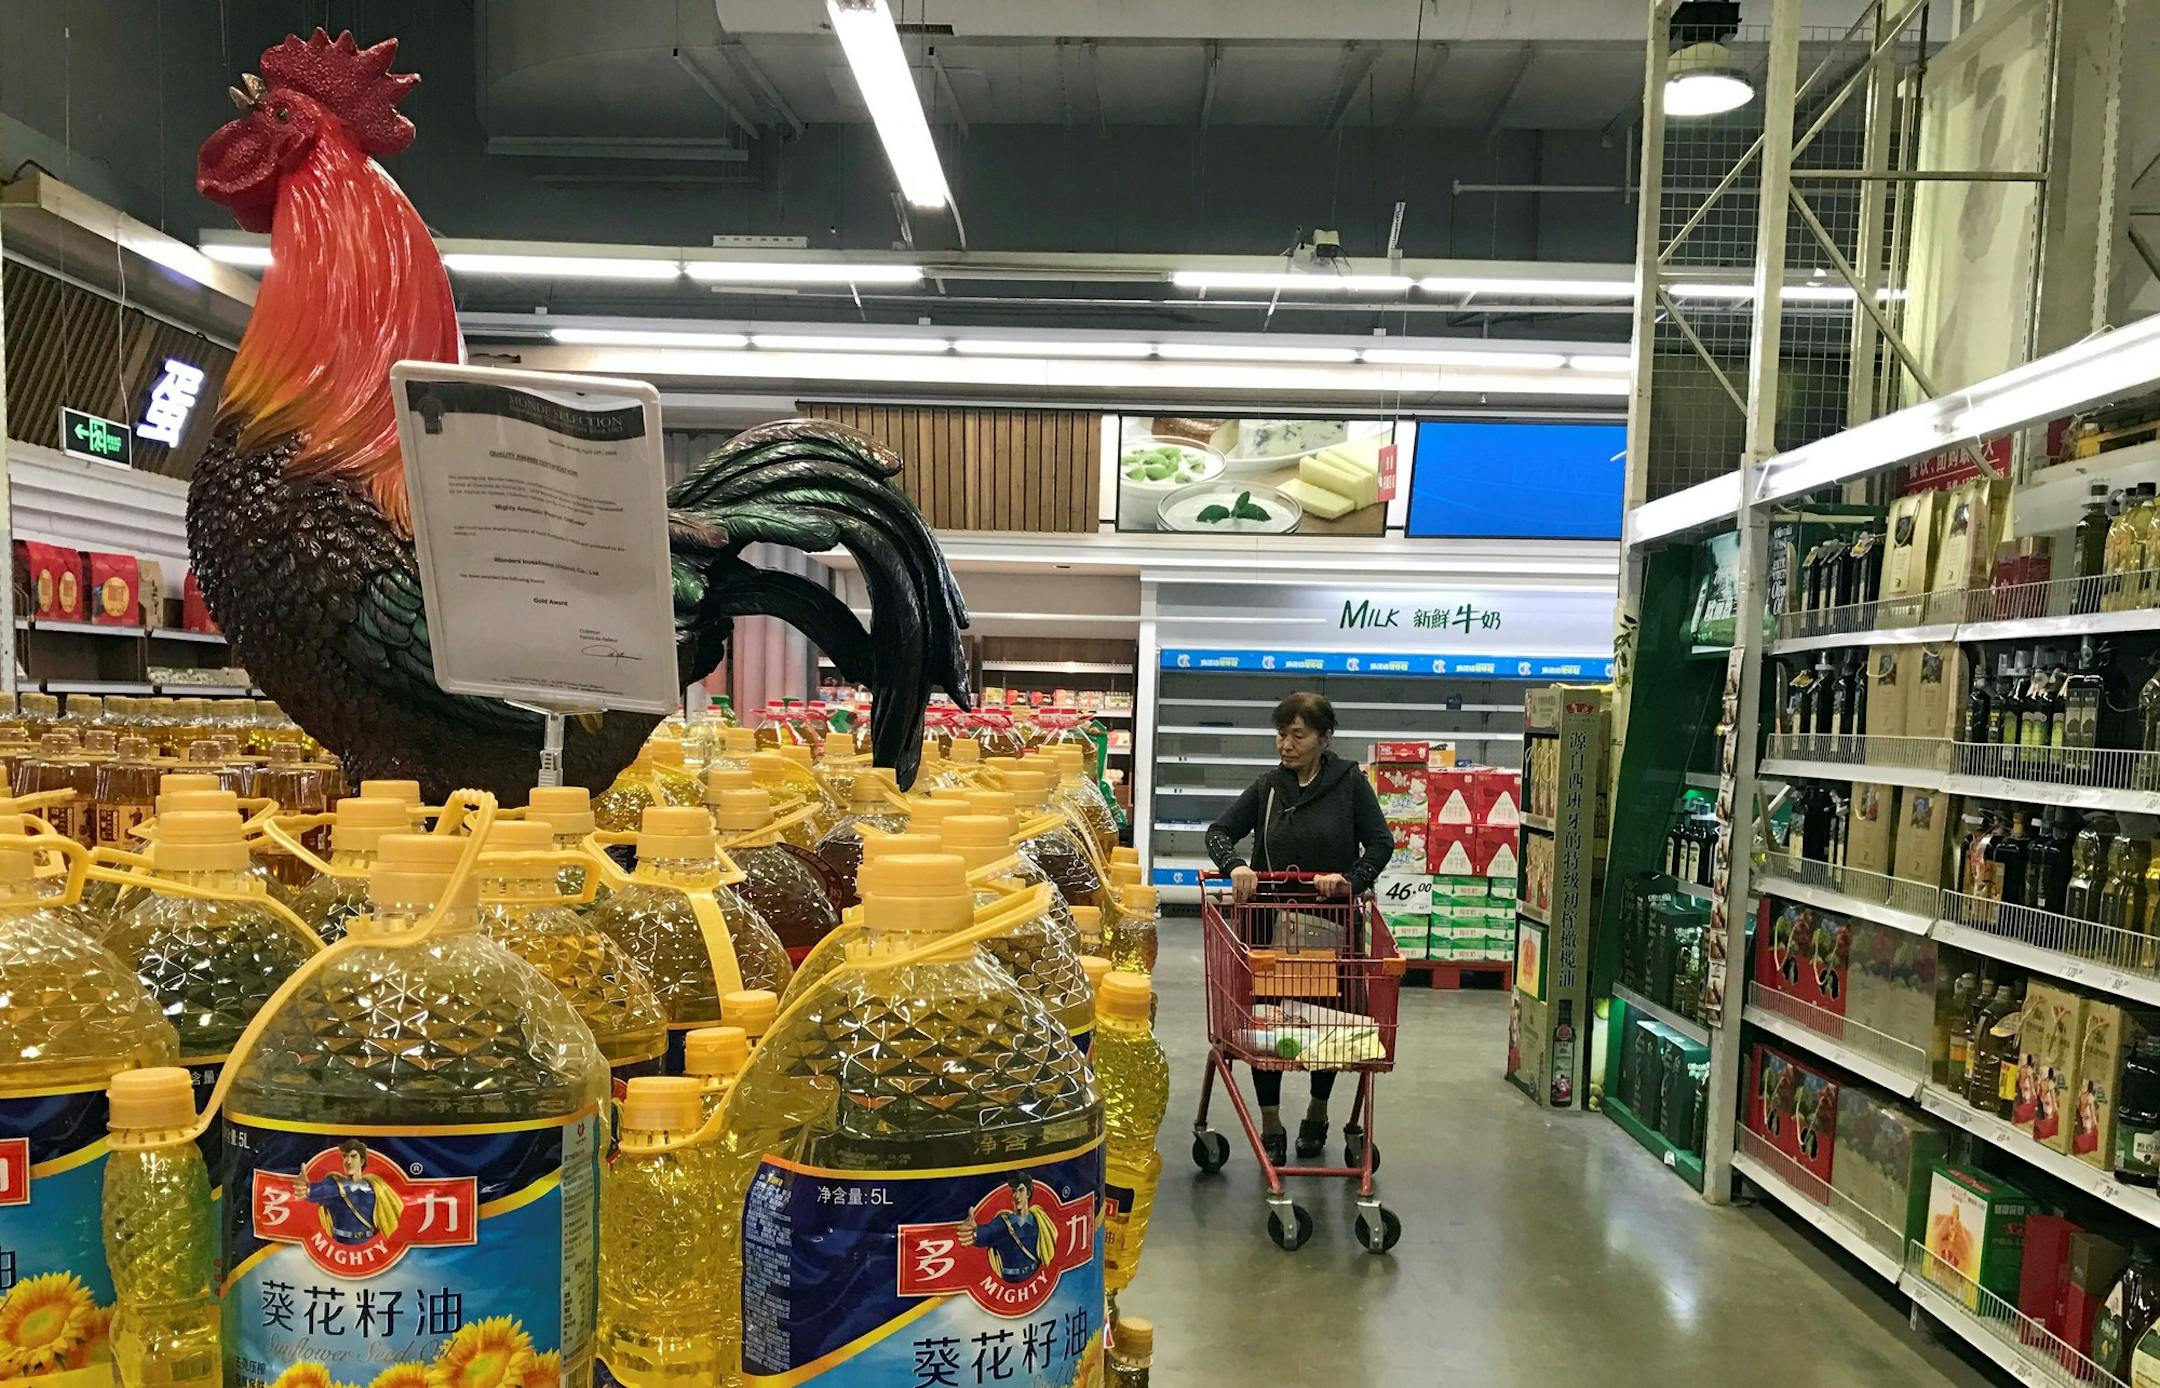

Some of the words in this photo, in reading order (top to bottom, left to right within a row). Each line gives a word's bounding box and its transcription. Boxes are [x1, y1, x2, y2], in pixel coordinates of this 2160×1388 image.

[533, 597, 549, 605] Gold
[549, 599, 569, 607] Award
[1558, 731, 1588, 988] 源自西班牙的特级初榨橄榄油
[1386, 882, 1432, 901] 46.00
[261, 1186, 291, 1227] 多
[416, 1190, 458, 1234] 力
[816, 1185, 894, 1206] 净含量:5L
[310, 1231, 391, 1267] MIGHTY
[915, 1239, 956, 1283] 多
[1065, 1214, 1088, 1257] 力
[979, 1269, 1049, 1304] MIGHTY
[261, 1280, 463, 1339] 葵花籽油
[266, 1333, 352, 1364] Sunflower
[356, 1339, 416, 1364] Seed
[912, 1306, 1088, 1388] 葵花籽油
